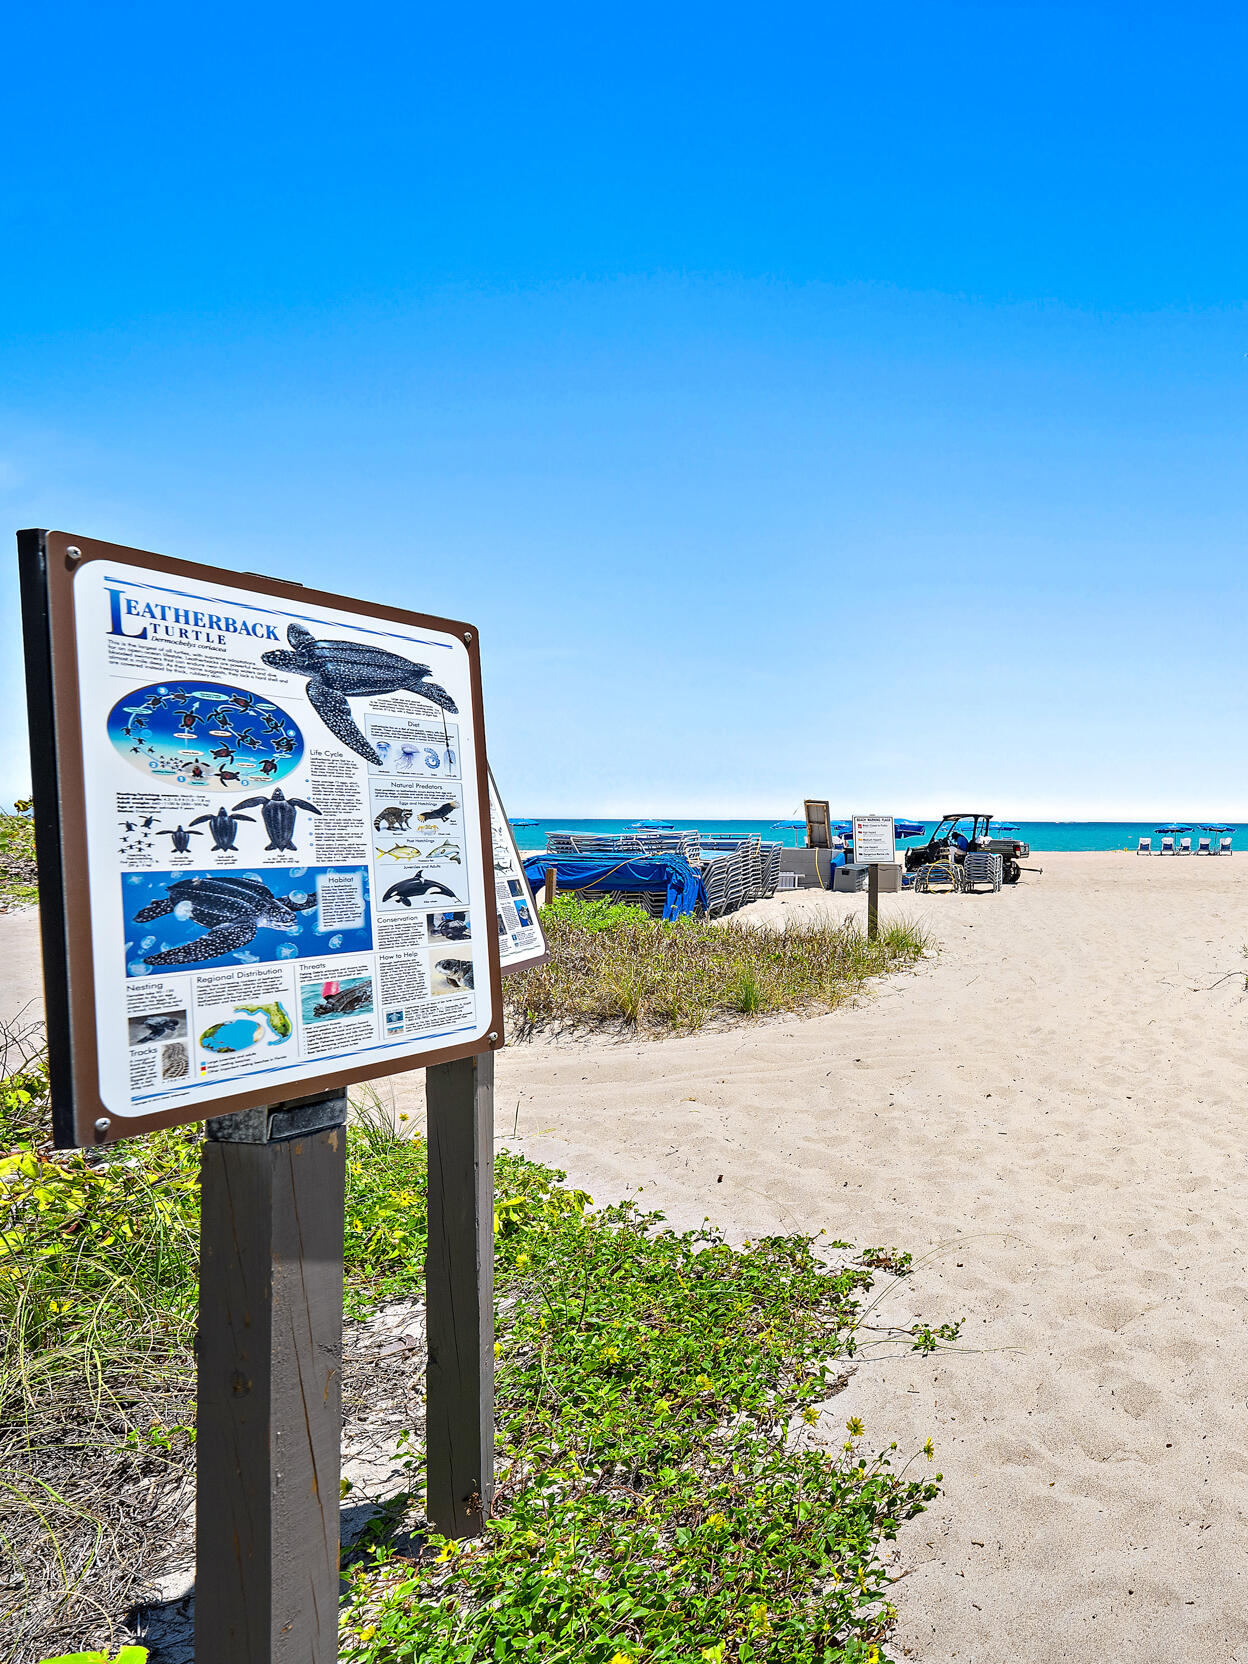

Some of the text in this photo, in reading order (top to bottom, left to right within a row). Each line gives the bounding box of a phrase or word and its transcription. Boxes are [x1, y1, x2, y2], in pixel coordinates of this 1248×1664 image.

[104, 587, 280, 641] LEATHERBACK
[150, 623, 226, 644] TURTLE
[377, 915, 418, 924] Conservation
[197, 968, 282, 984] Regional Distribution
[127, 982, 163, 991] Nesting
[130, 1047, 158, 1056] Tracks
